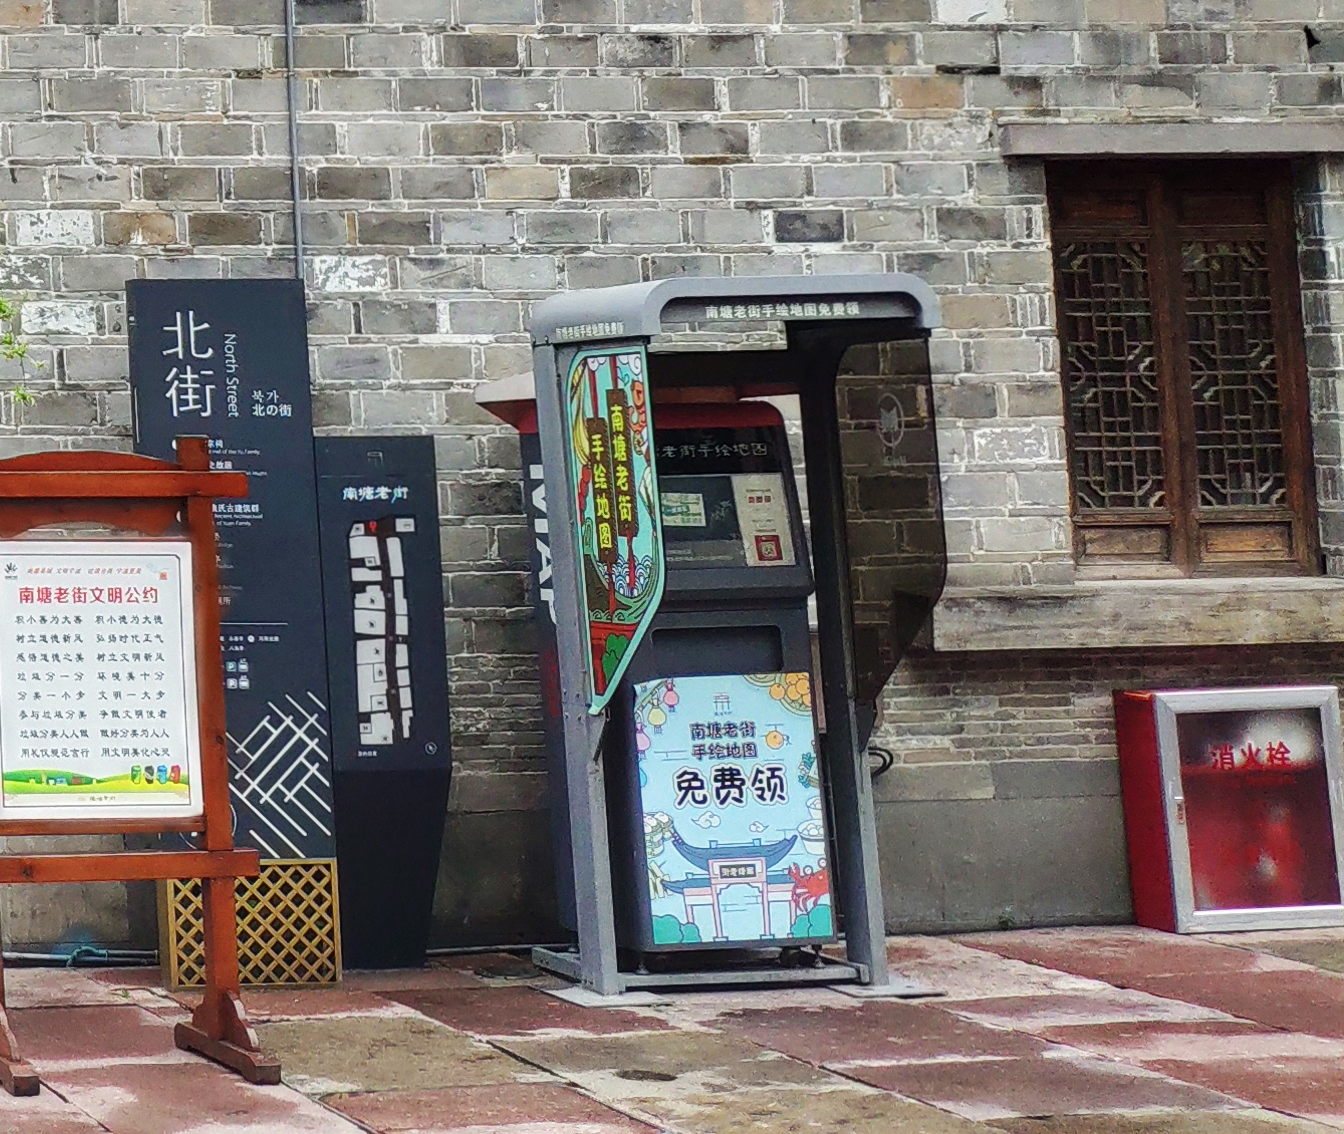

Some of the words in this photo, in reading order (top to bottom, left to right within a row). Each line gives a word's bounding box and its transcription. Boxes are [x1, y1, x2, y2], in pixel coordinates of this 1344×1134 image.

[705, 302, 861, 320] 南塘老街手绘地图免费领
[161, 309, 216, 417] 北街
[223, 333, 239, 373] North
[226, 377, 240, 417] Street
[252, 403, 292, 417] 北の街
[610, 403, 633, 523] 南塘老街
[656, 443, 768, 459] 老街手绘地图
[590, 433, 613, 549] 手绘地图
[18, 586, 159, 604] 南塘老街文明公约
[689, 721, 756, 742] 南塘老街
[691, 742, 758, 761] 手绘地图
[1212, 741, 1291, 770] 消火栓
[674, 765, 788, 807] 免费领
